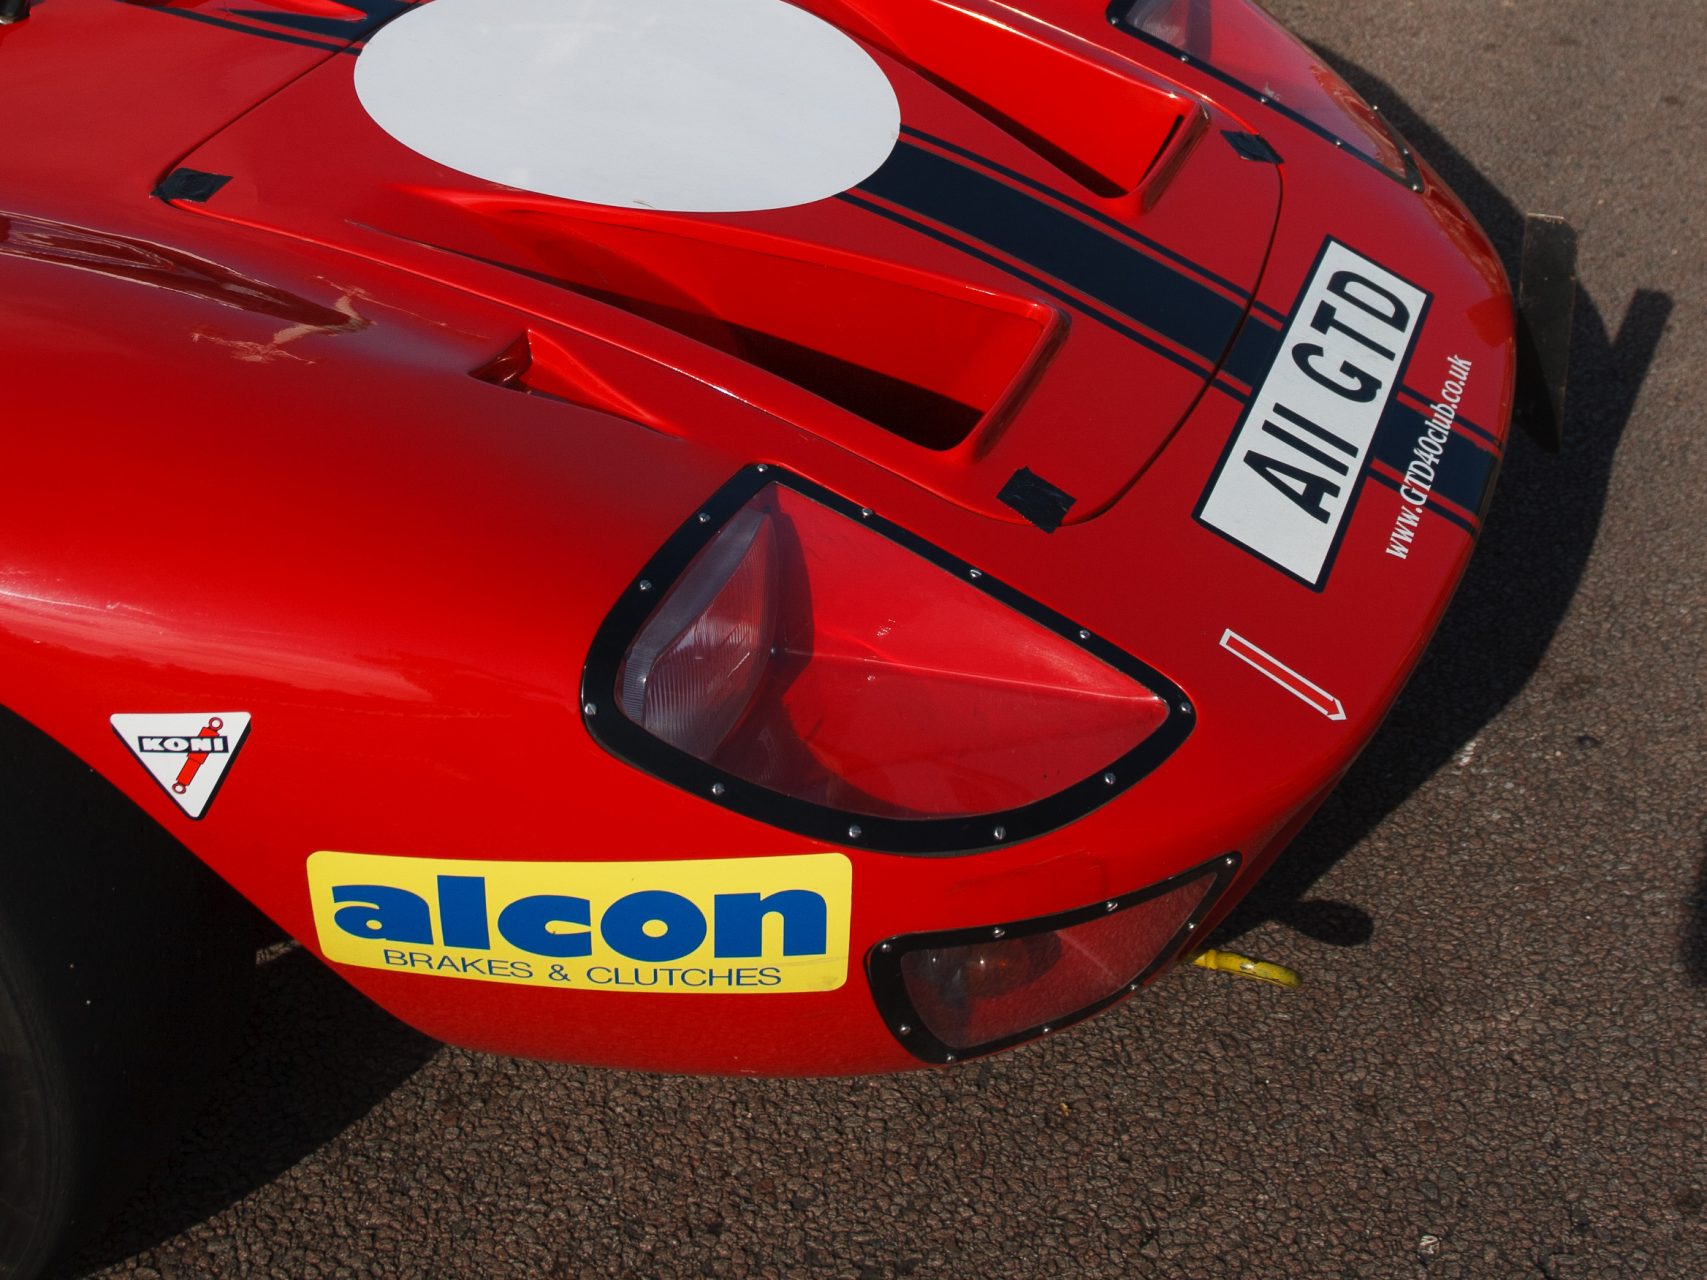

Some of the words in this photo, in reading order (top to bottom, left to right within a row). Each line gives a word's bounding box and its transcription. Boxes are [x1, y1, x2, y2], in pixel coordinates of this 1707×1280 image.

[1291, 270, 1410, 403] GTD
[1385, 354, 1472, 559] www.GTD40club.co.uk
[141, 737, 224, 751] KONI
[331, 875, 828, 962] alcon
[383, 949, 533, 978] BRAKES
[548, 963, 571, 982] &
[586, 966, 782, 987] CLUTCHES
